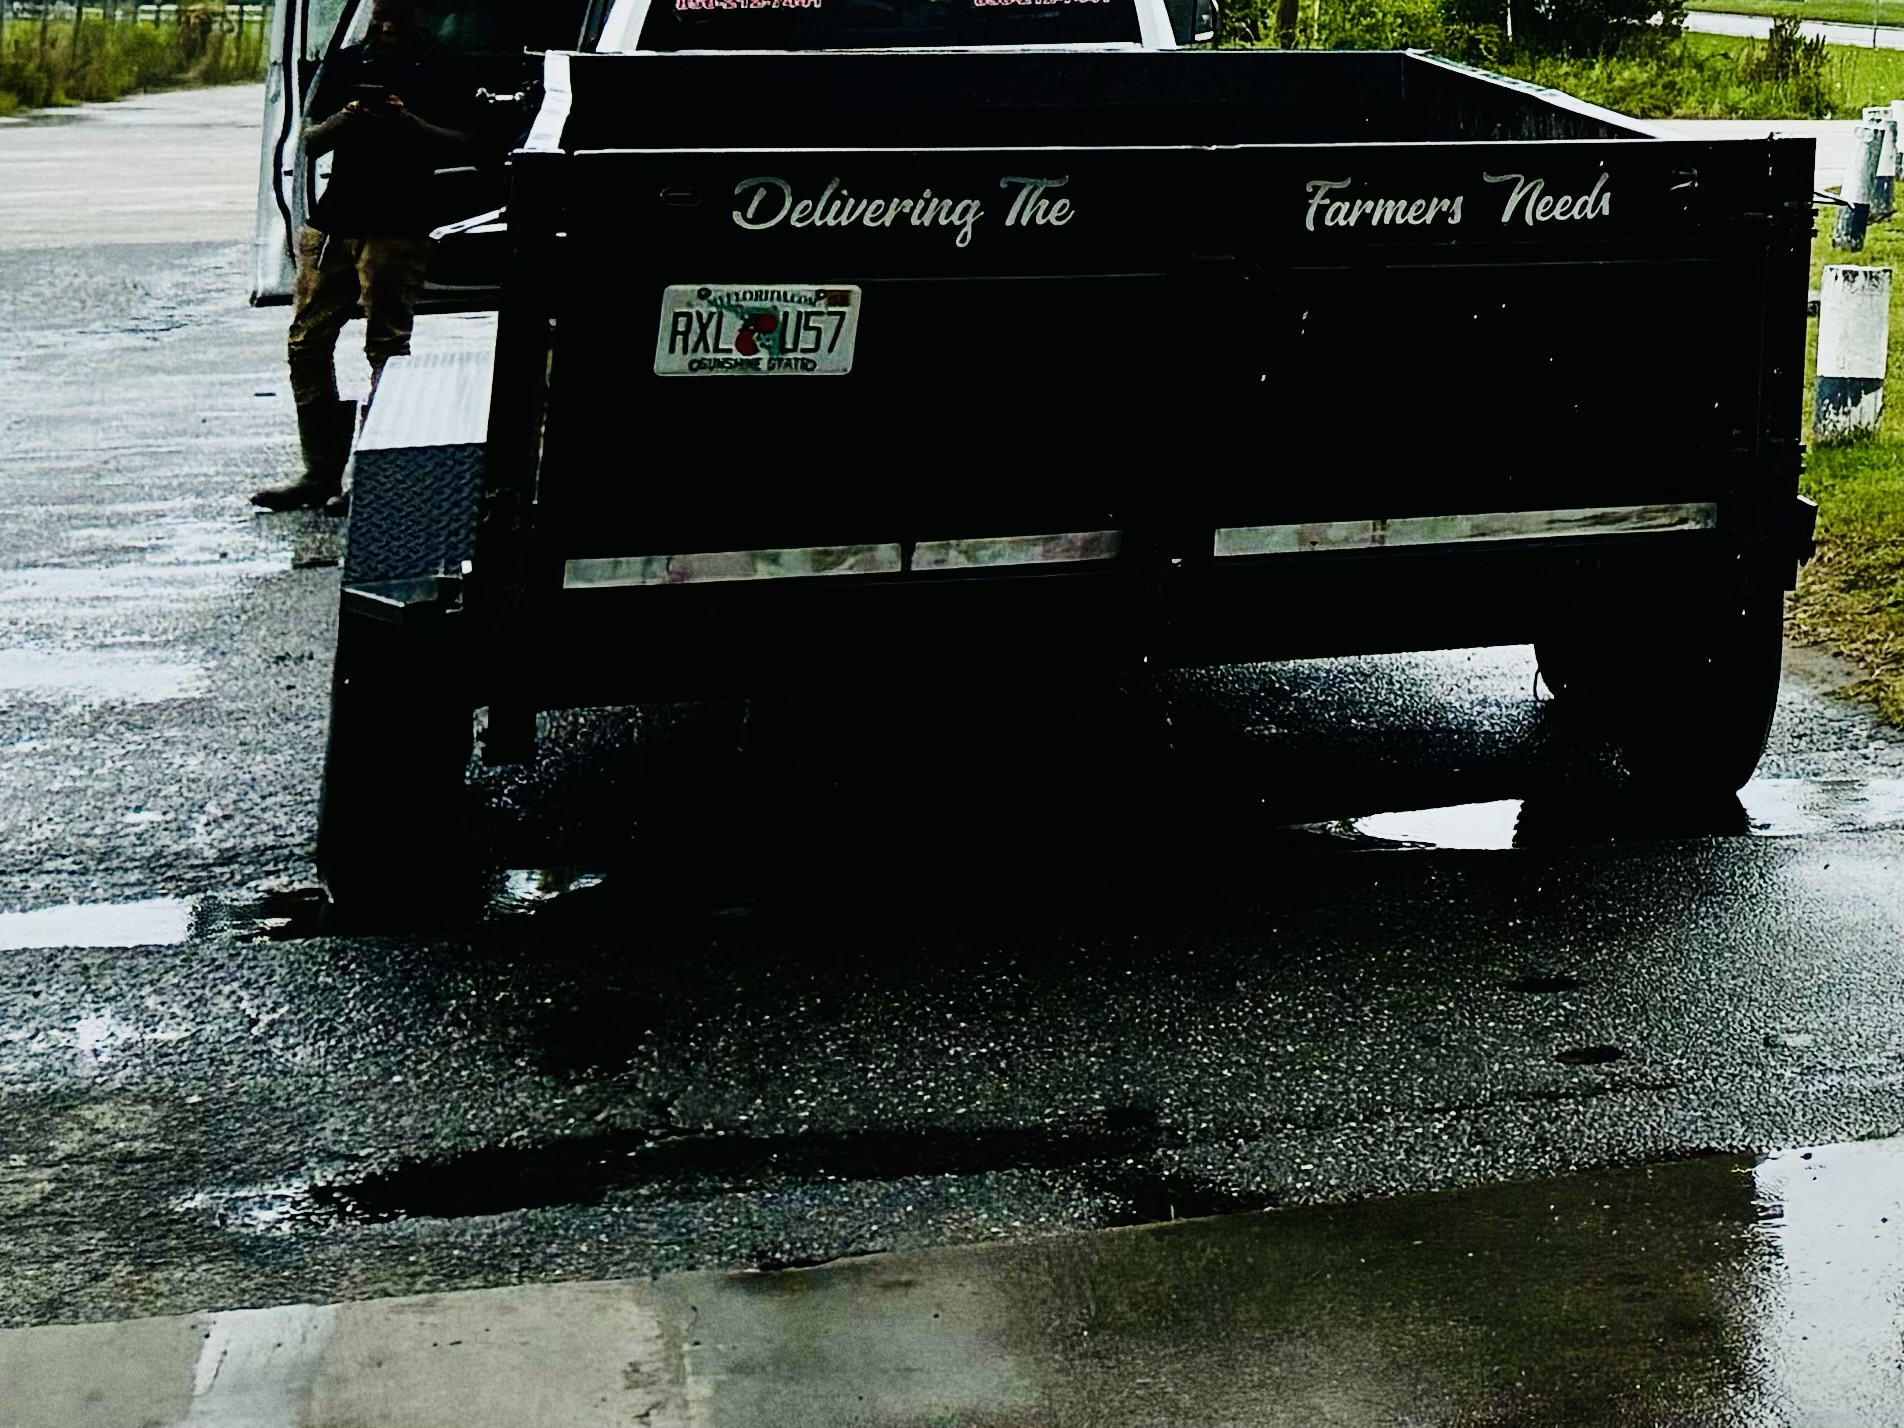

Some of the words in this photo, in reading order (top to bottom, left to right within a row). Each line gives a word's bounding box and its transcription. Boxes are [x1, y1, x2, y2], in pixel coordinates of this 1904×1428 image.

[732, 175, 985, 248] Delivering
[999, 173, 1076, 228] The
[1304, 177, 1464, 233] Farmers
[1482, 171, 1612, 227] Needs
[780, 309, 847, 355] U57
